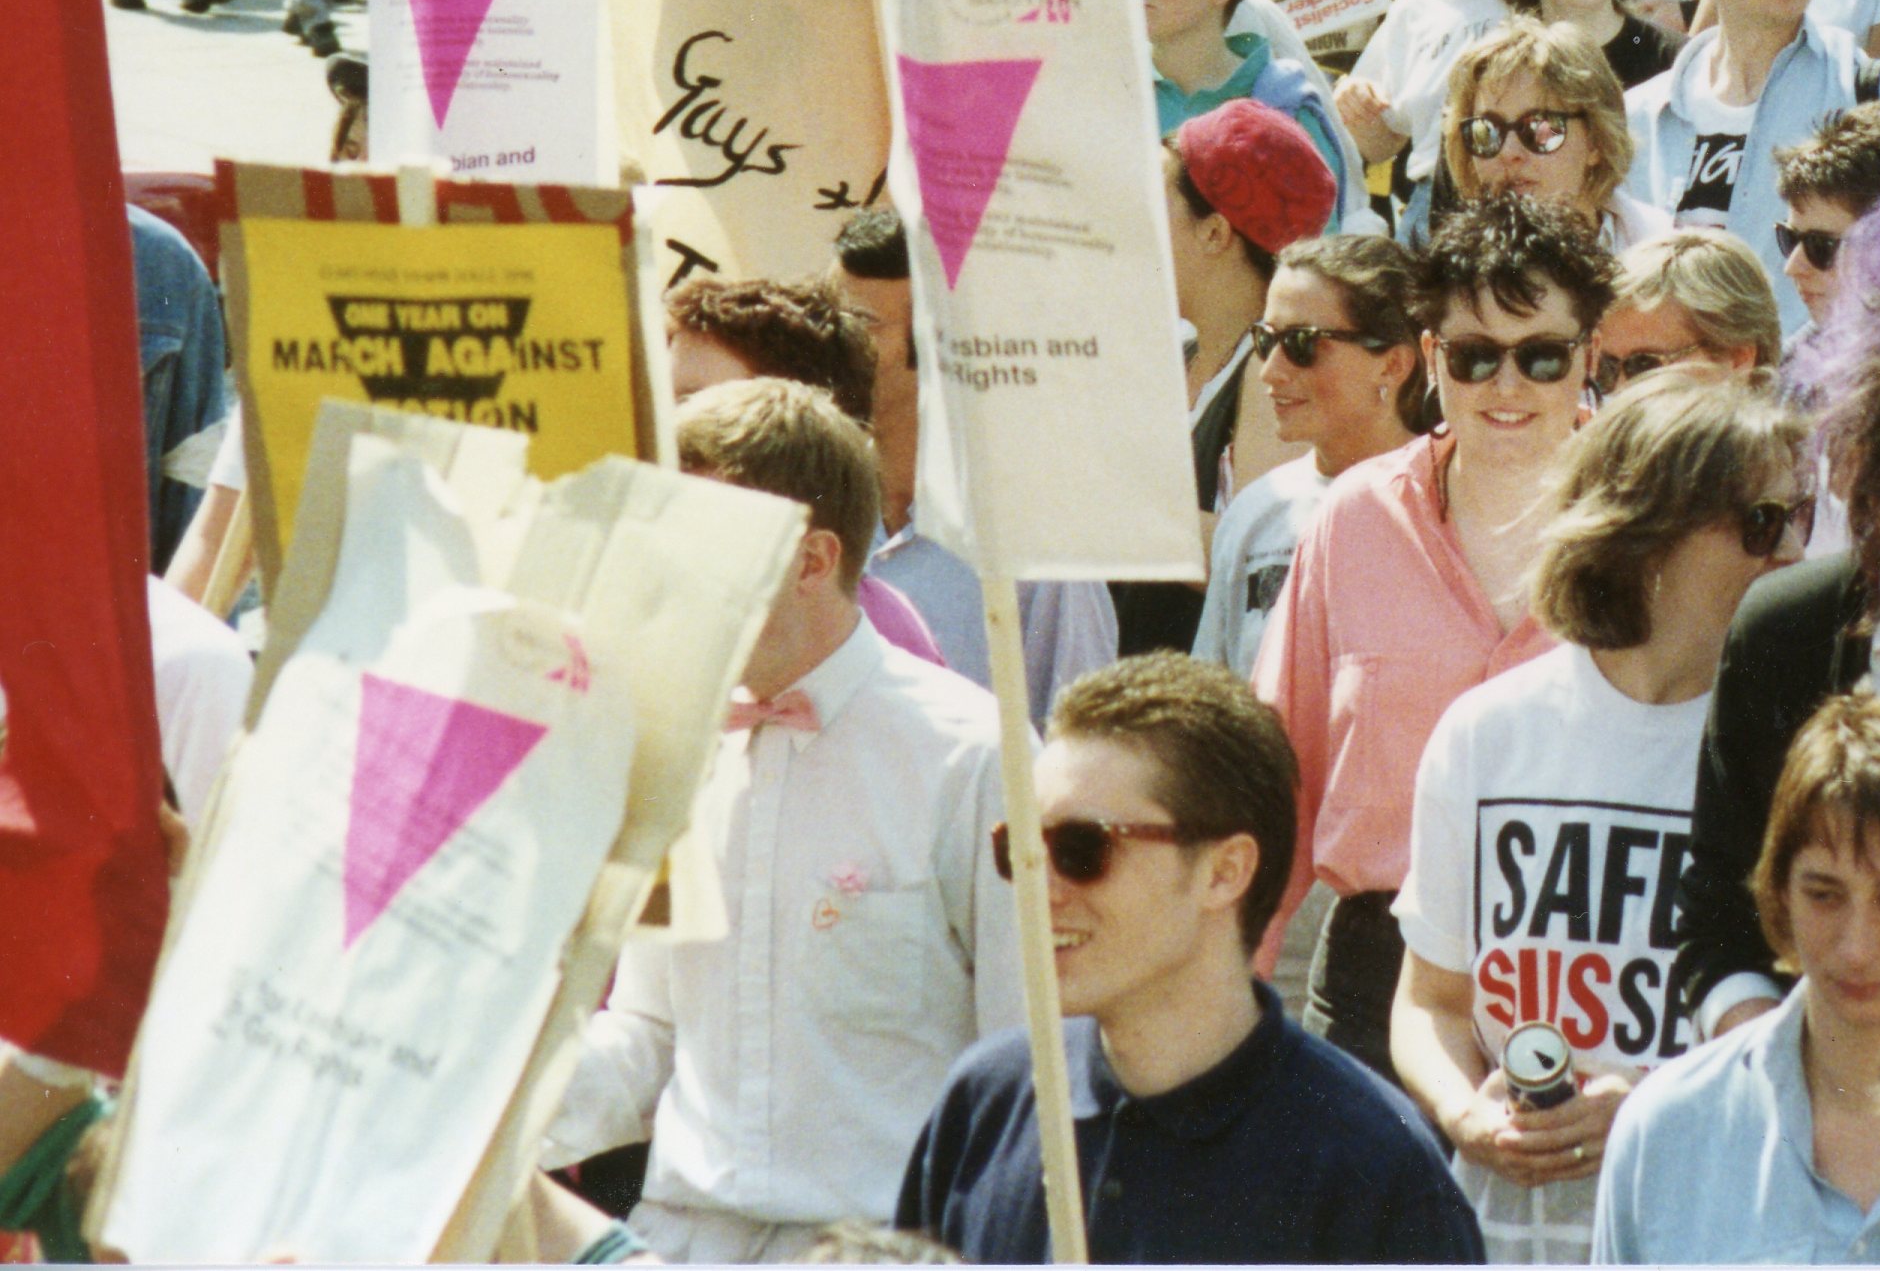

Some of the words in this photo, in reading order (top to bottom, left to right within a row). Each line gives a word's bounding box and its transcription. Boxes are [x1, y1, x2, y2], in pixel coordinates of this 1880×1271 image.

[653, 30, 805, 187] Gays
[496, 145, 537, 166] and
[344, 302, 390, 329] ONE
[394, 303, 461, 330] YEAR
[467, 301, 508, 329] ON
[273, 336, 403, 376] MARCH
[425, 336, 605, 376] AGAINST
[945, 332, 1038, 359] esbian
[1046, 334, 1100, 359] and
[1492, 819, 1694, 950] SAFE
